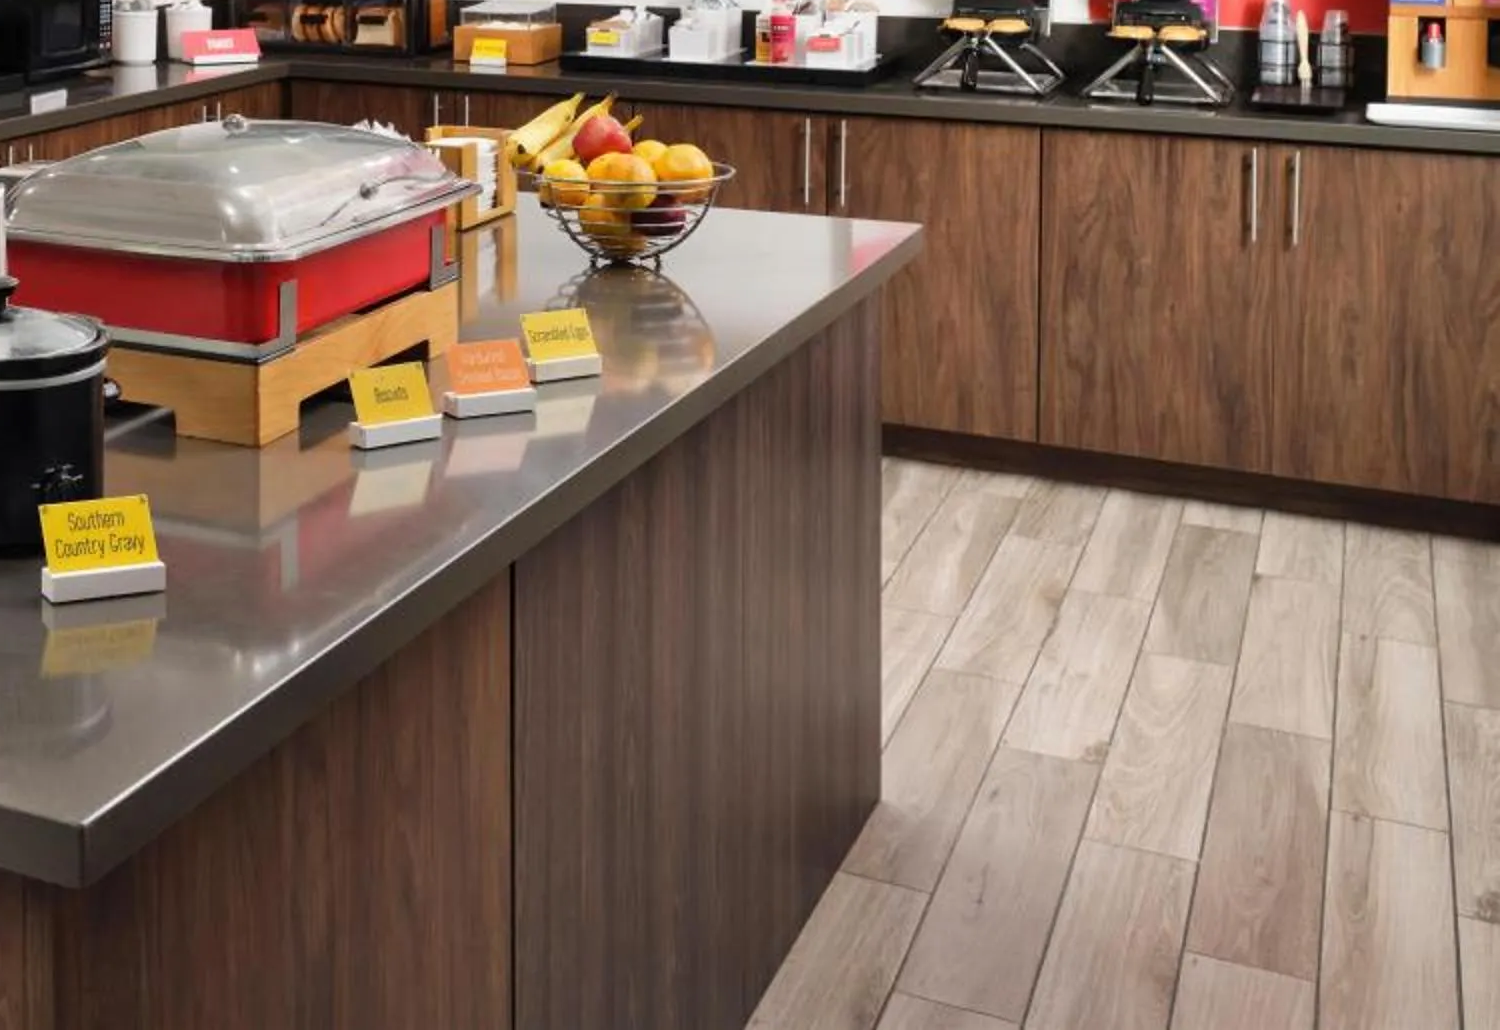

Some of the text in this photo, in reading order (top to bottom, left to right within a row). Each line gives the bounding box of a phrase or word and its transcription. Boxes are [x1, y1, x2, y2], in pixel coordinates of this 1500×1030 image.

[67, 510, 125, 532] Southern
[55, 532, 146, 559] Country Gravy
